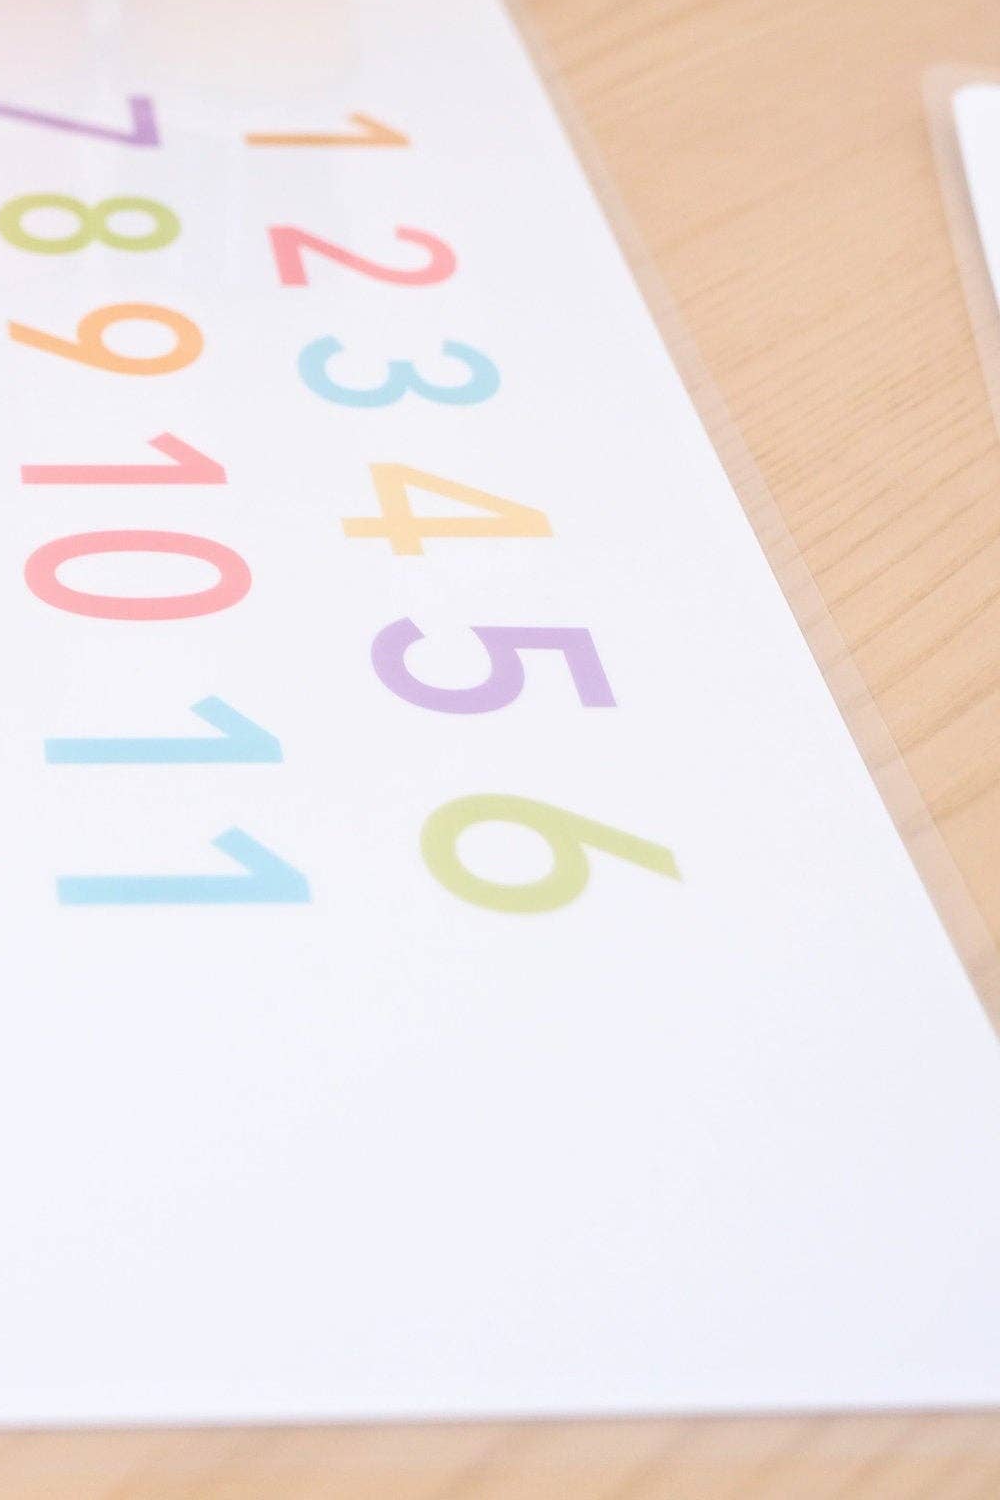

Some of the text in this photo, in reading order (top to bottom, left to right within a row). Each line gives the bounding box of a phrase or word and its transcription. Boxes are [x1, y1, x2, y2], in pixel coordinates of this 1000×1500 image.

[7, 301, 205, 377] 9
[20, 432, 252, 621] 10
[244, 112, 677, 913] 1 2 3 4 5 6
[45, 697, 311, 905] 11
